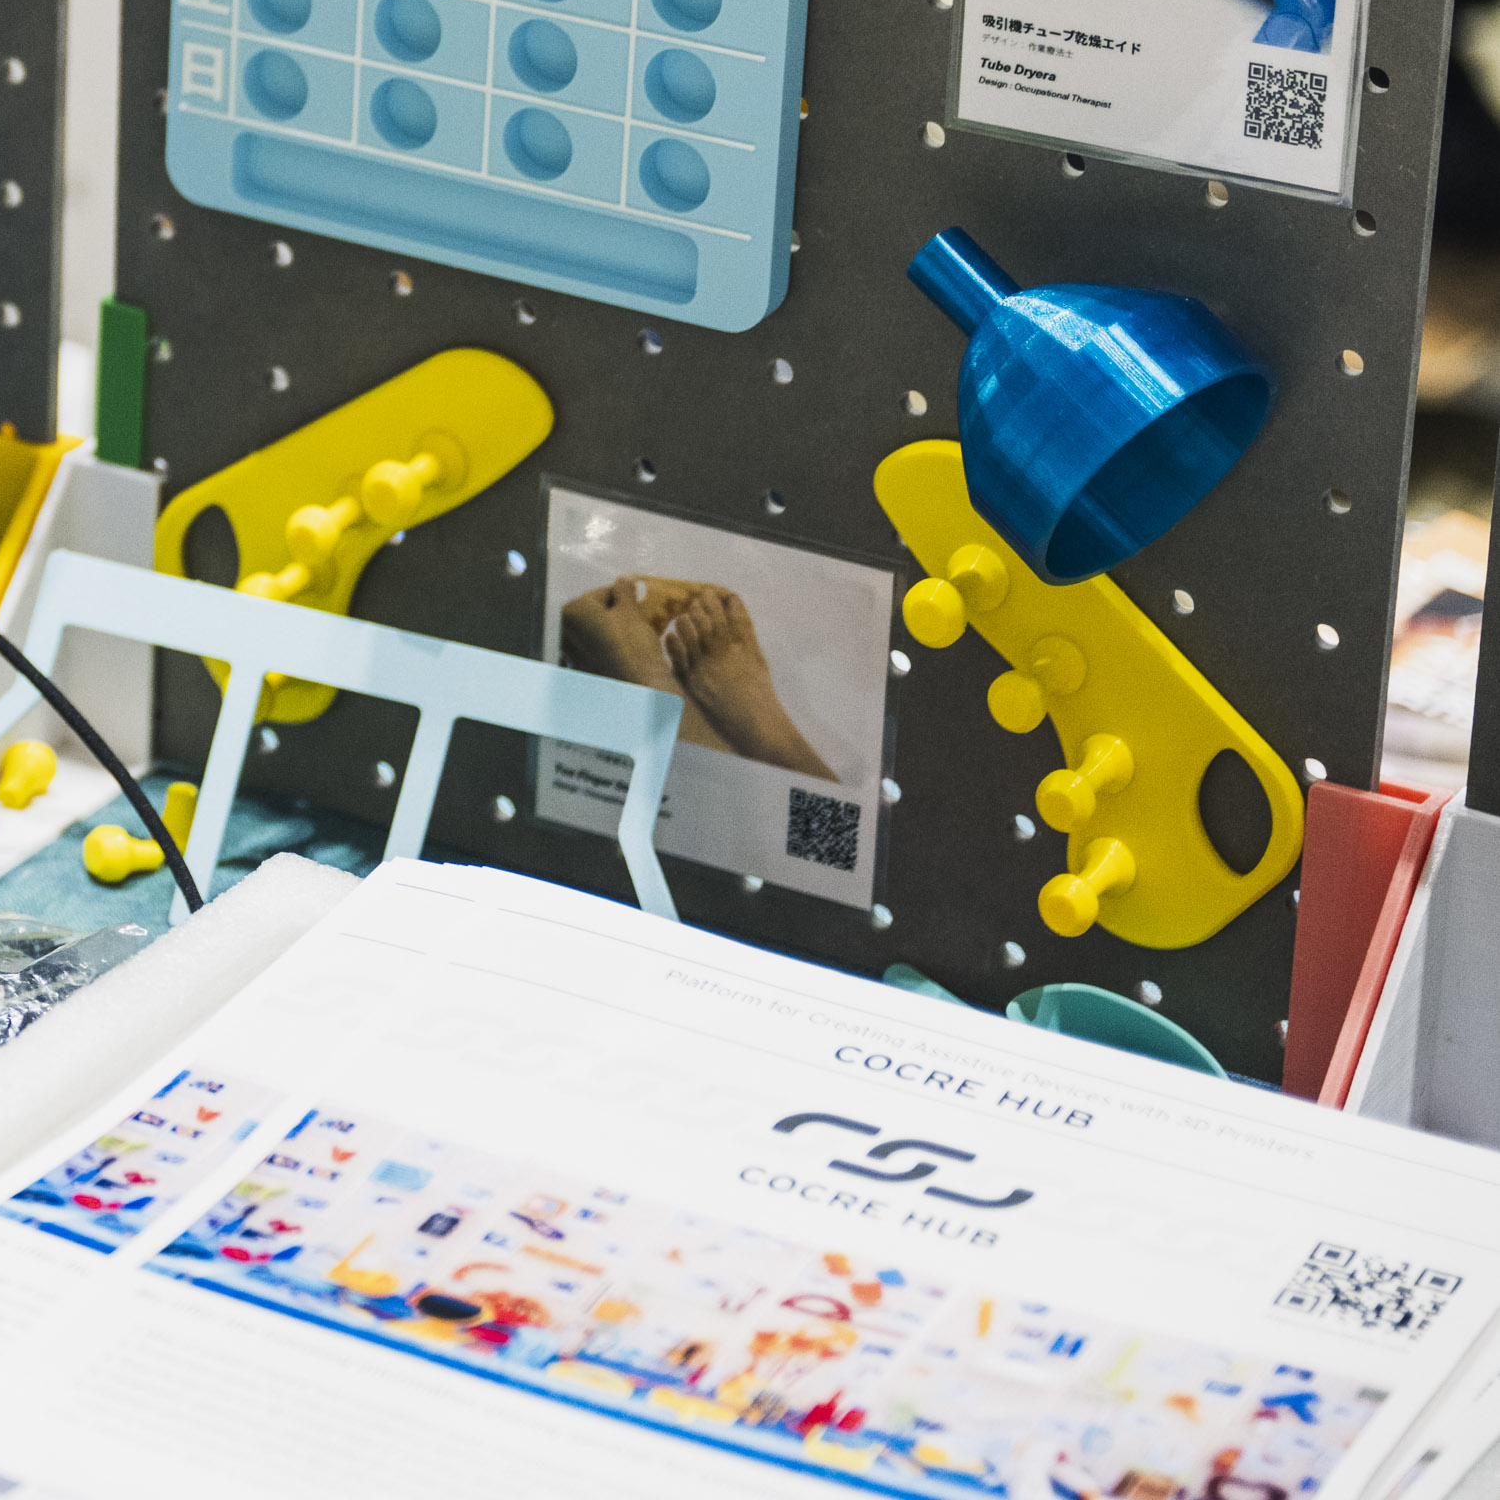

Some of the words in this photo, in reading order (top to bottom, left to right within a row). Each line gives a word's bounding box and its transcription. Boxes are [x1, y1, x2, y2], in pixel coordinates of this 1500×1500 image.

[180, 41, 225, 102] 日
[978, 75, 1008, 89] Design
[1014, 82, 1070, 101] Occupational
[1071, 93, 1112, 109] Therapist
[980, 57, 1011, 73] Tube
[1013, 64, 1056, 82] Dryera
[664, 967, 762, 1009] Platform
[768, 998, 803, 1017] for
[808, 1011, 906, 1049] Creating
[833, 1045, 985, 1100] COCRE
[997, 1090, 1095, 1129] HUB
[738, 1165, 890, 1220] COCRE
[902, 1211, 999, 1247] HUB
